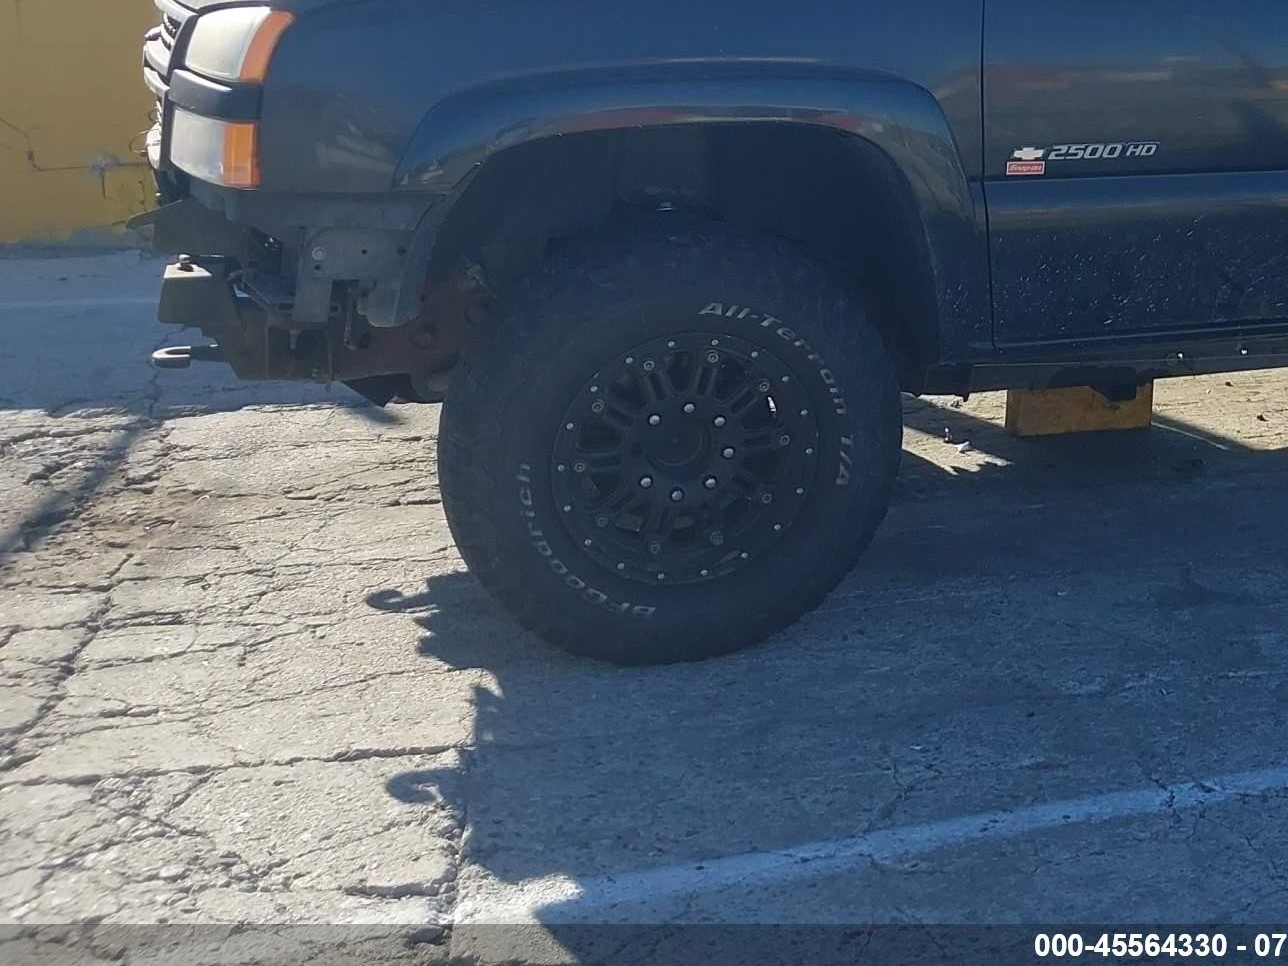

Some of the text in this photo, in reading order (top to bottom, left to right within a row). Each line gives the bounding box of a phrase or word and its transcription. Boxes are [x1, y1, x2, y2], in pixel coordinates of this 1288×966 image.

[1048, 144, 1157, 160] 2500 HD
[698, 302, 854, 485] All-Terrain T/A
